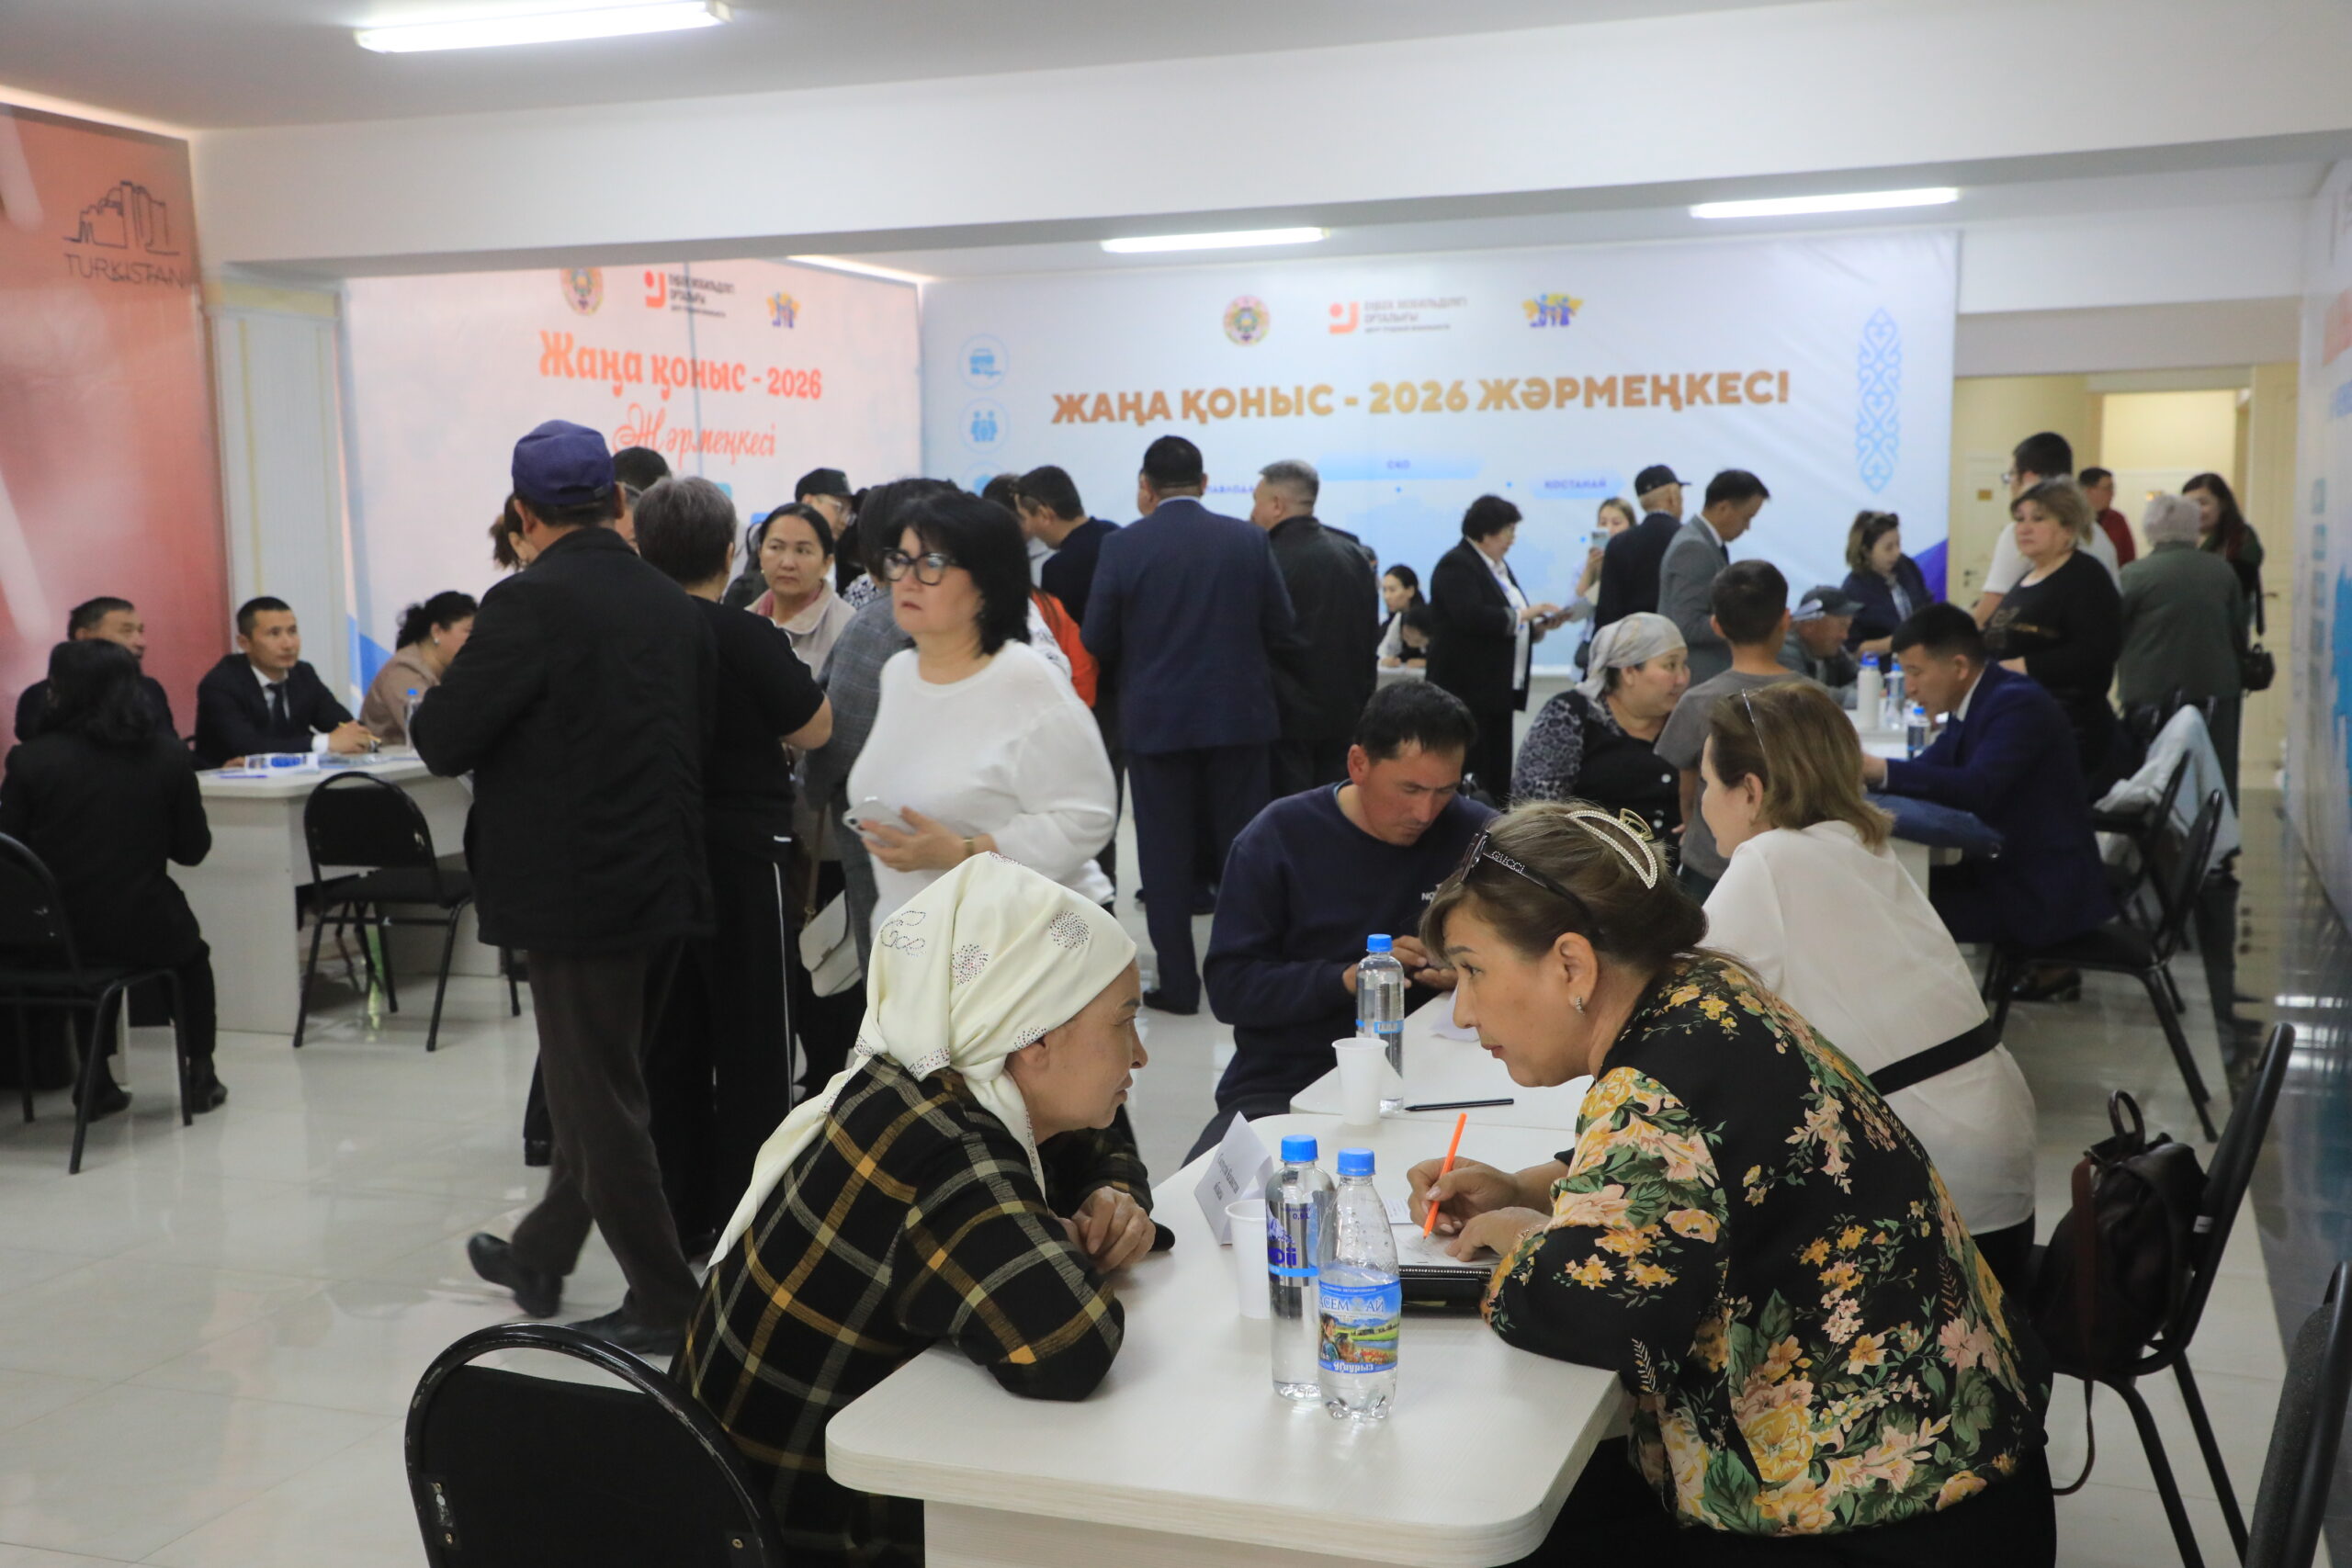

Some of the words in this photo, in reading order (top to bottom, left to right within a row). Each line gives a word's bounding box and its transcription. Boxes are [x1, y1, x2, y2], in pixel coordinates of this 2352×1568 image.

[63, 253, 185, 289] TURKISTAN
[538, 330, 644, 398] Жаңа
[651, 355, 746, 400] қоныс
[767, 367, 822, 400] 2026
[1051, 389, 1173, 426] ЖАҢА
[1181, 384, 1335, 424] ҚОНЫС
[1369, 379, 1469, 414] 2026
[1476, 370, 1790, 412] ЖӘРМЕҢКЕСІ
[1491, 851, 1526, 874] GUCCI
